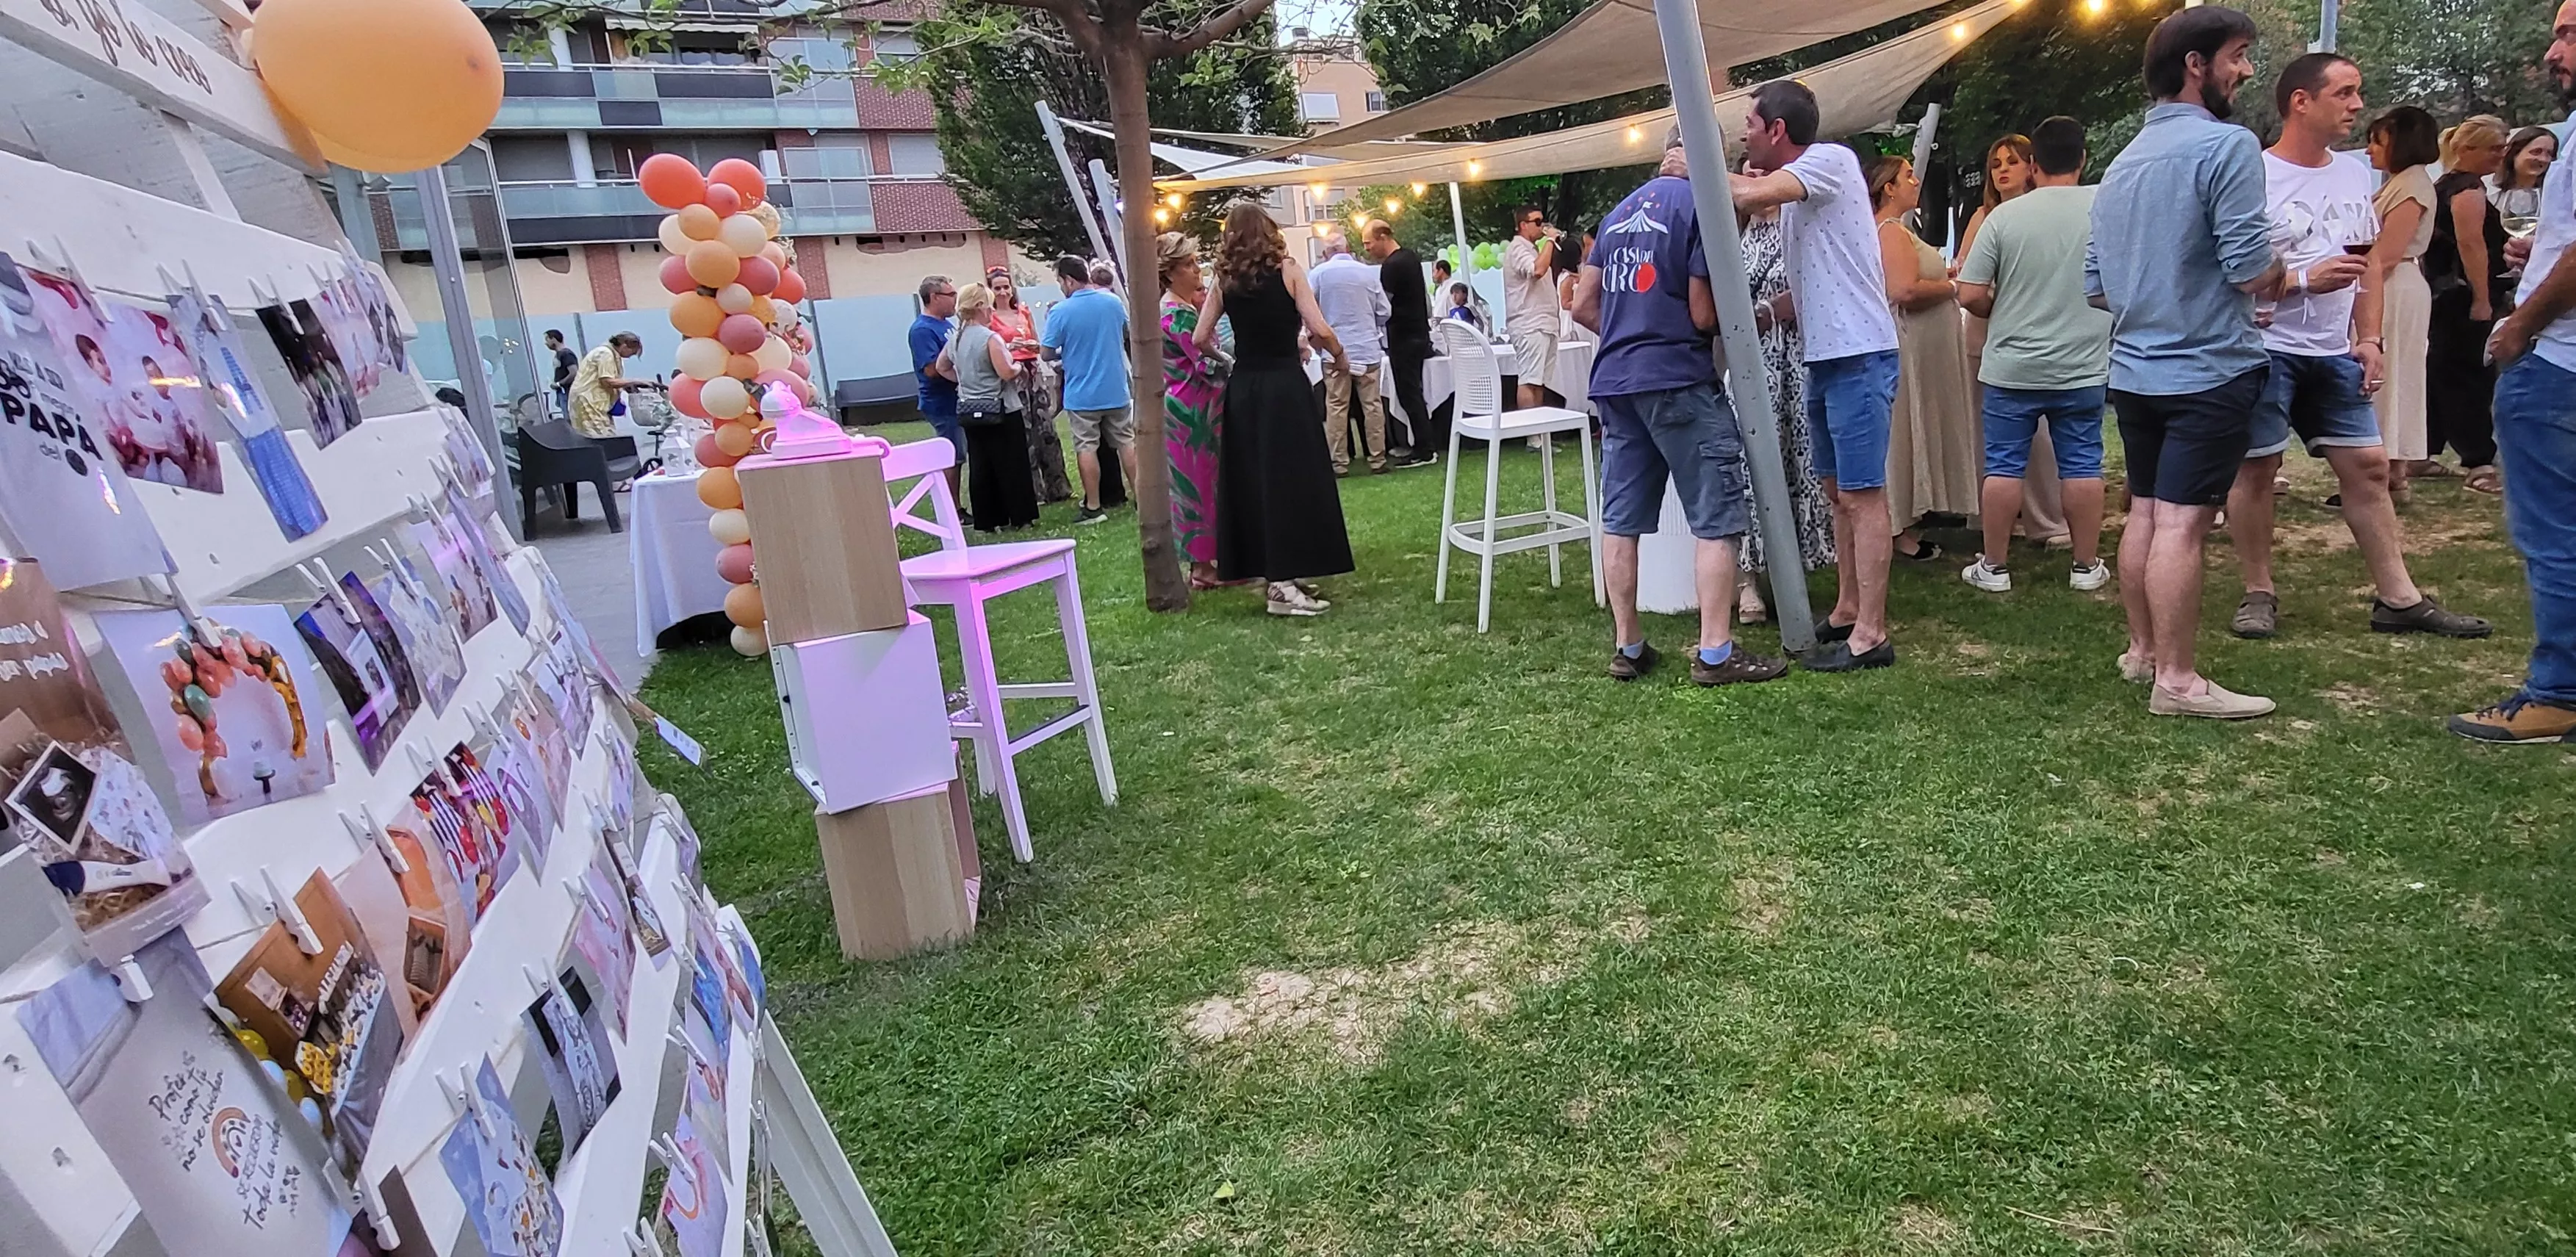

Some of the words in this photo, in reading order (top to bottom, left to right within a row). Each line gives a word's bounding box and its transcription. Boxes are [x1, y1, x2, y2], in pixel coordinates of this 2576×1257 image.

[0, 392, 104, 461] PAPÁ
[182, 1147, 198, 1173] no
[193, 1126, 206, 1148] se
